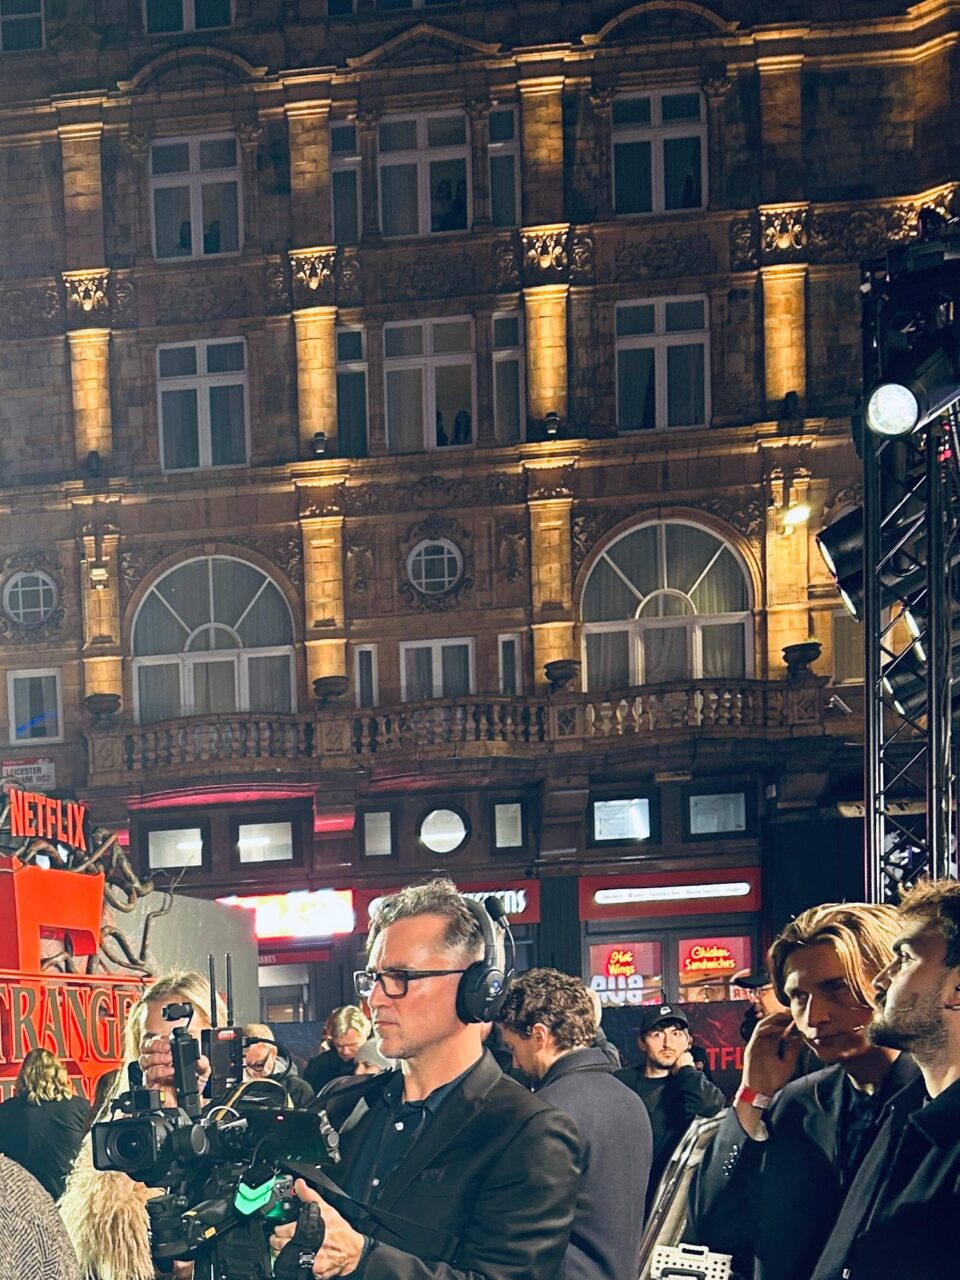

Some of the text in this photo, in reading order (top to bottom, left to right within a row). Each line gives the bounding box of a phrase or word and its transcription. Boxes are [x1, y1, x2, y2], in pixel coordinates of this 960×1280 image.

[6, 766, 42, 776] LEICESTER
[9, 788, 87, 852] NETFLIX
[609, 950, 634, 964] Hot
[690, 945, 731, 959] Chicken
[607, 963, 637, 976] Wings
[684, 957, 736, 971] Sandwiches
